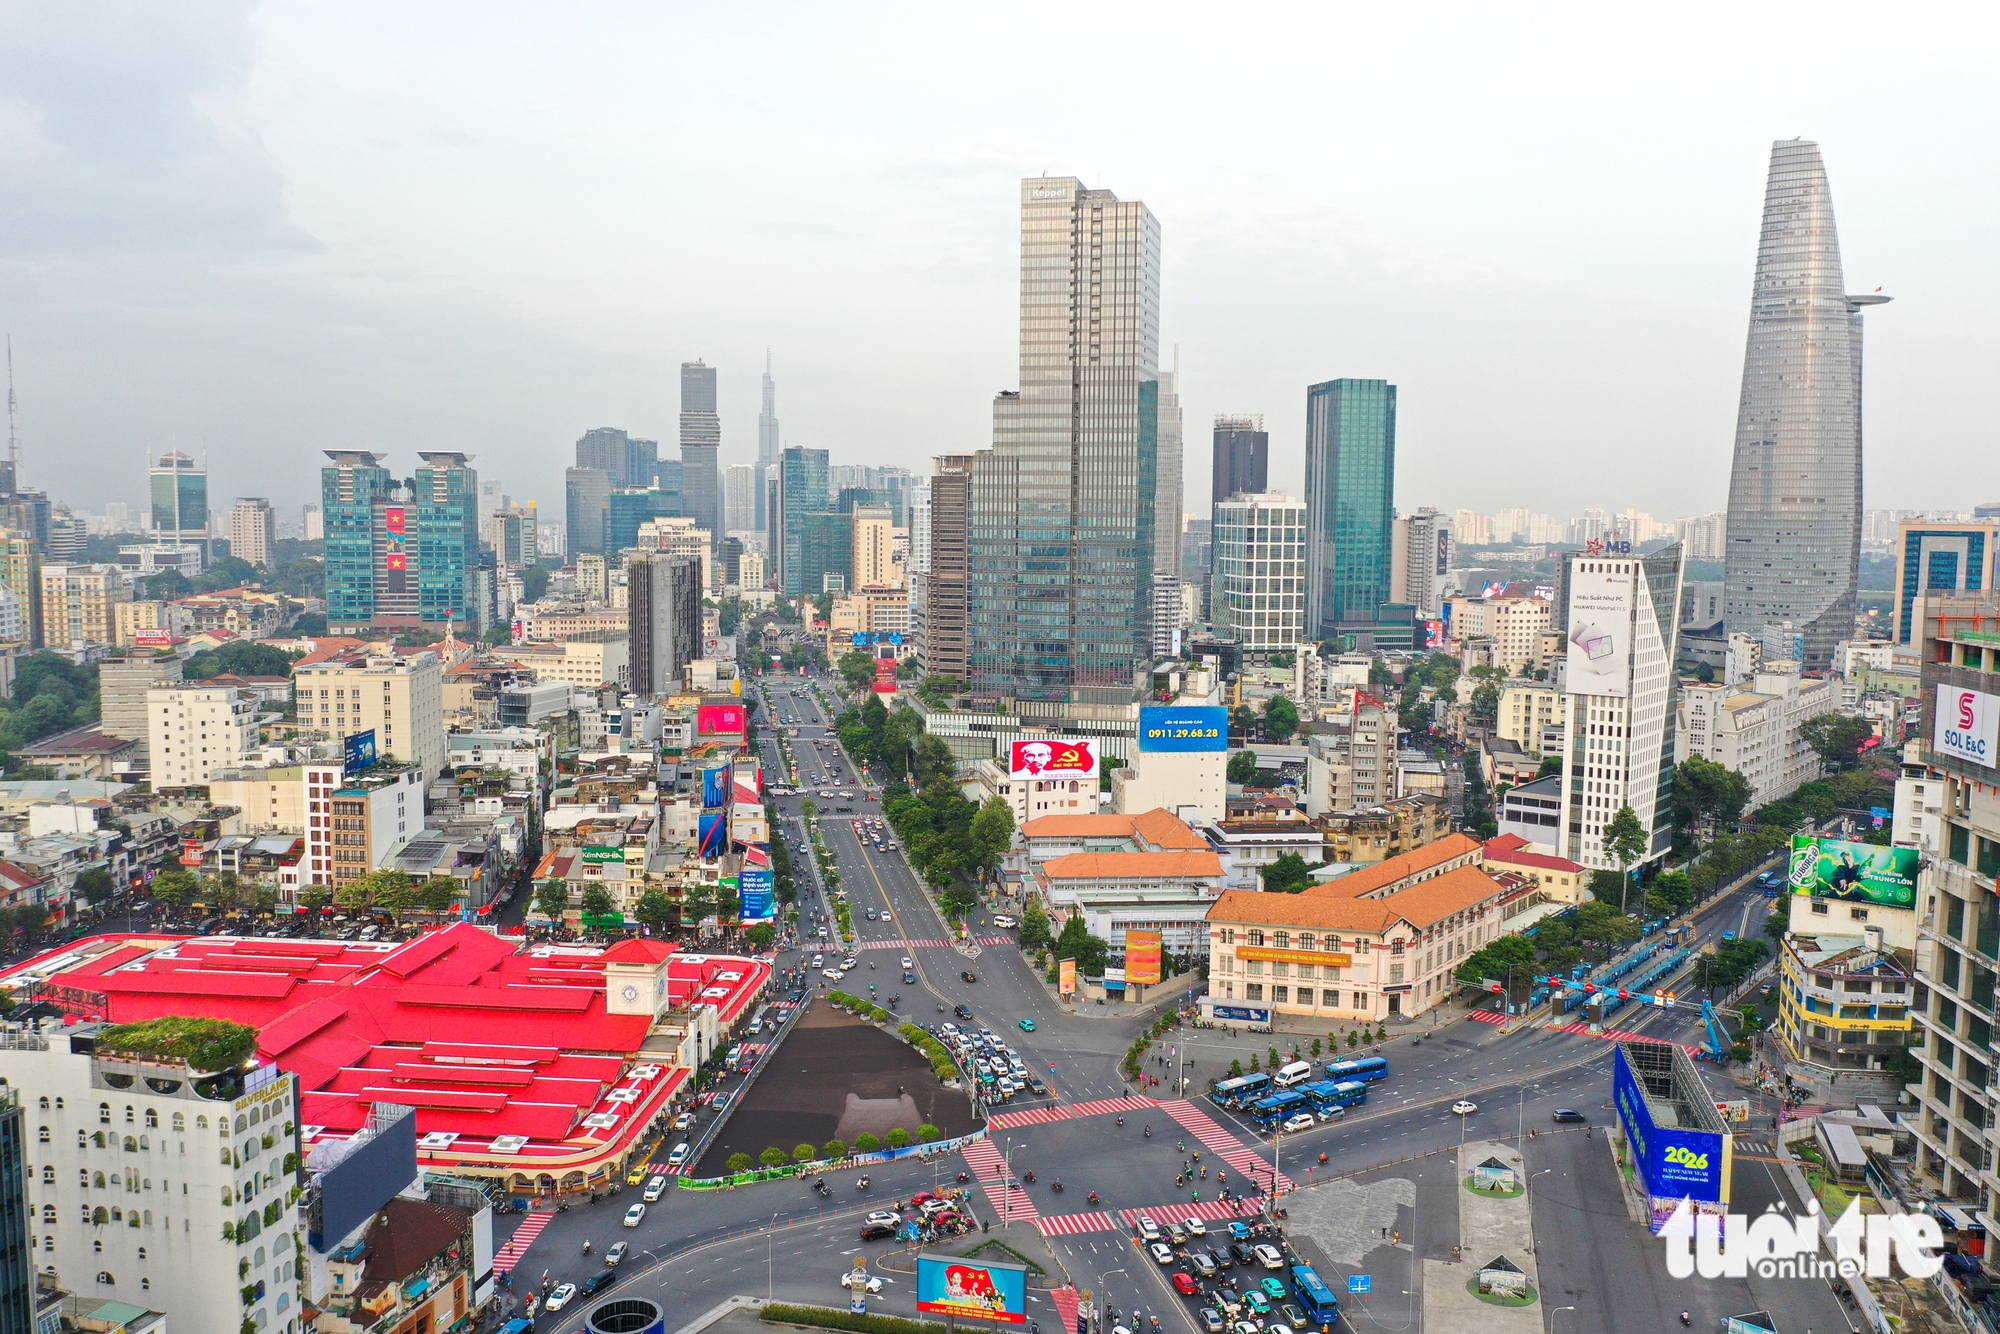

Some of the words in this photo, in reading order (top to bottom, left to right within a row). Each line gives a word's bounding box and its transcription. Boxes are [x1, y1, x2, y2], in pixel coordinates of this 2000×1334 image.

[1032, 189, 1064, 198] Keppel
[1606, 540, 1630, 553] MB
[1148, 729, 1218, 738] 0911.29.68.28
[1945, 730, 1963, 749] SOL
[1966, 735, 1985, 754] E&C
[1792, 854, 1816, 882] TUBORG
[236, 1077, 290, 1112] SILVERLAND
[1664, 1146, 1708, 1169] 2026
